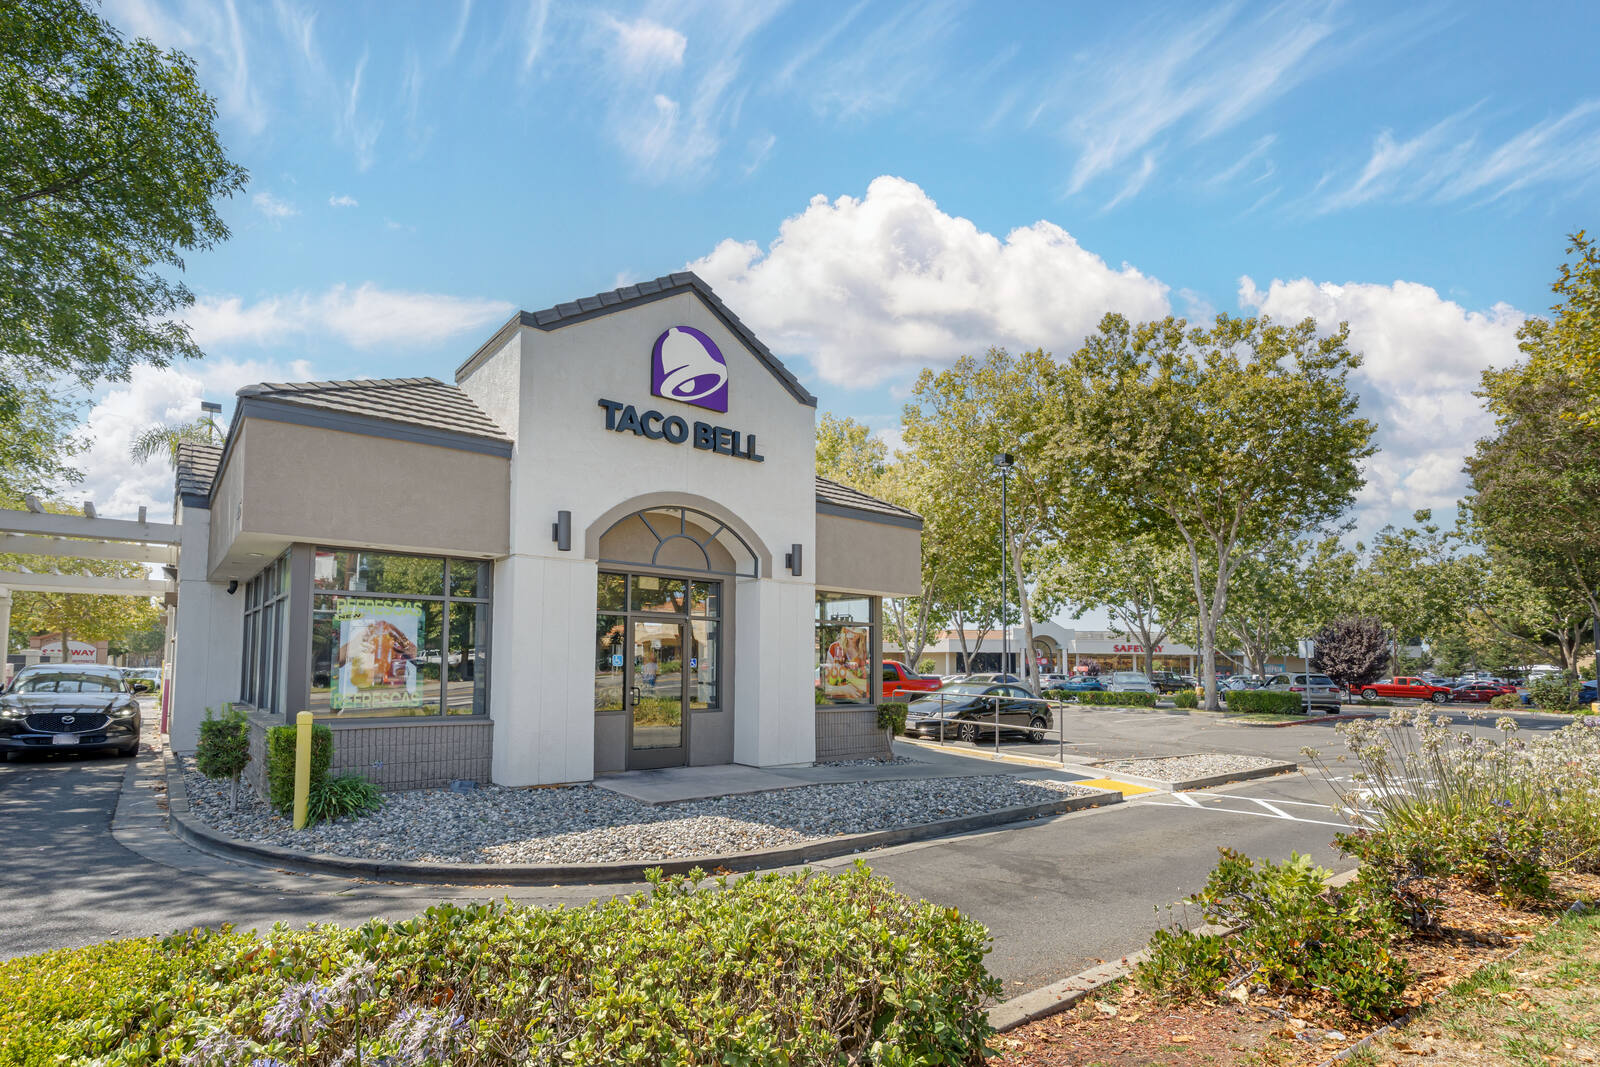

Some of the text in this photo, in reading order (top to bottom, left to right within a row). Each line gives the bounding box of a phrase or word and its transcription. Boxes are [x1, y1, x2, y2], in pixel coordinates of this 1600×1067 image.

[598, 398, 764, 462] TACO BELL
[336, 598, 423, 617] REFRESCAS
[333, 691, 421, 709] REFRESCAS
